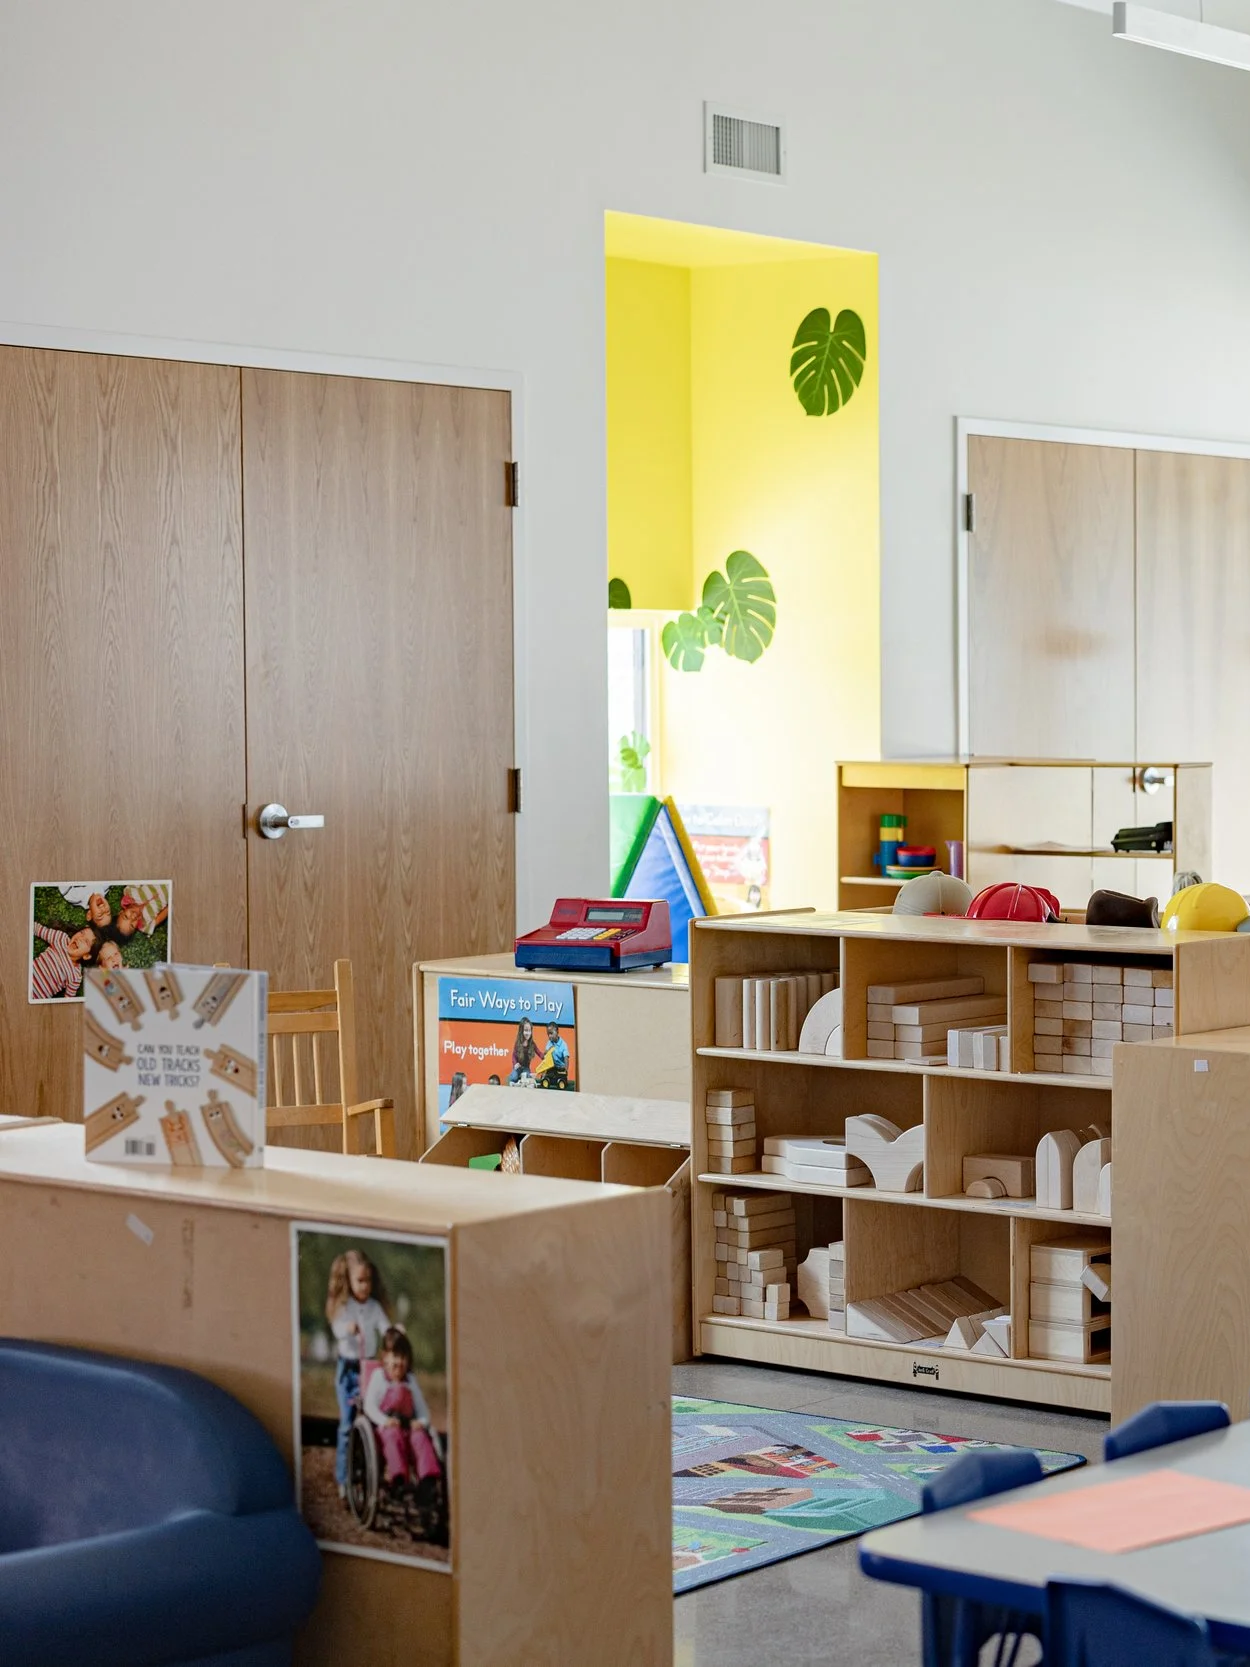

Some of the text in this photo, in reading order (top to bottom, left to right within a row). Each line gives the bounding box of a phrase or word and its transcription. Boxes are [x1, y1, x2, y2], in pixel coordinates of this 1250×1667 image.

[450, 989, 563, 1019] Fair Ways to Play
[137, 1044, 200, 1056] CAN YOU TEACH
[443, 1040, 509, 1060] Play together
[136, 1057, 201, 1073] OLD TRACKS
[138, 1073, 201, 1087] NEW TRICKS?
